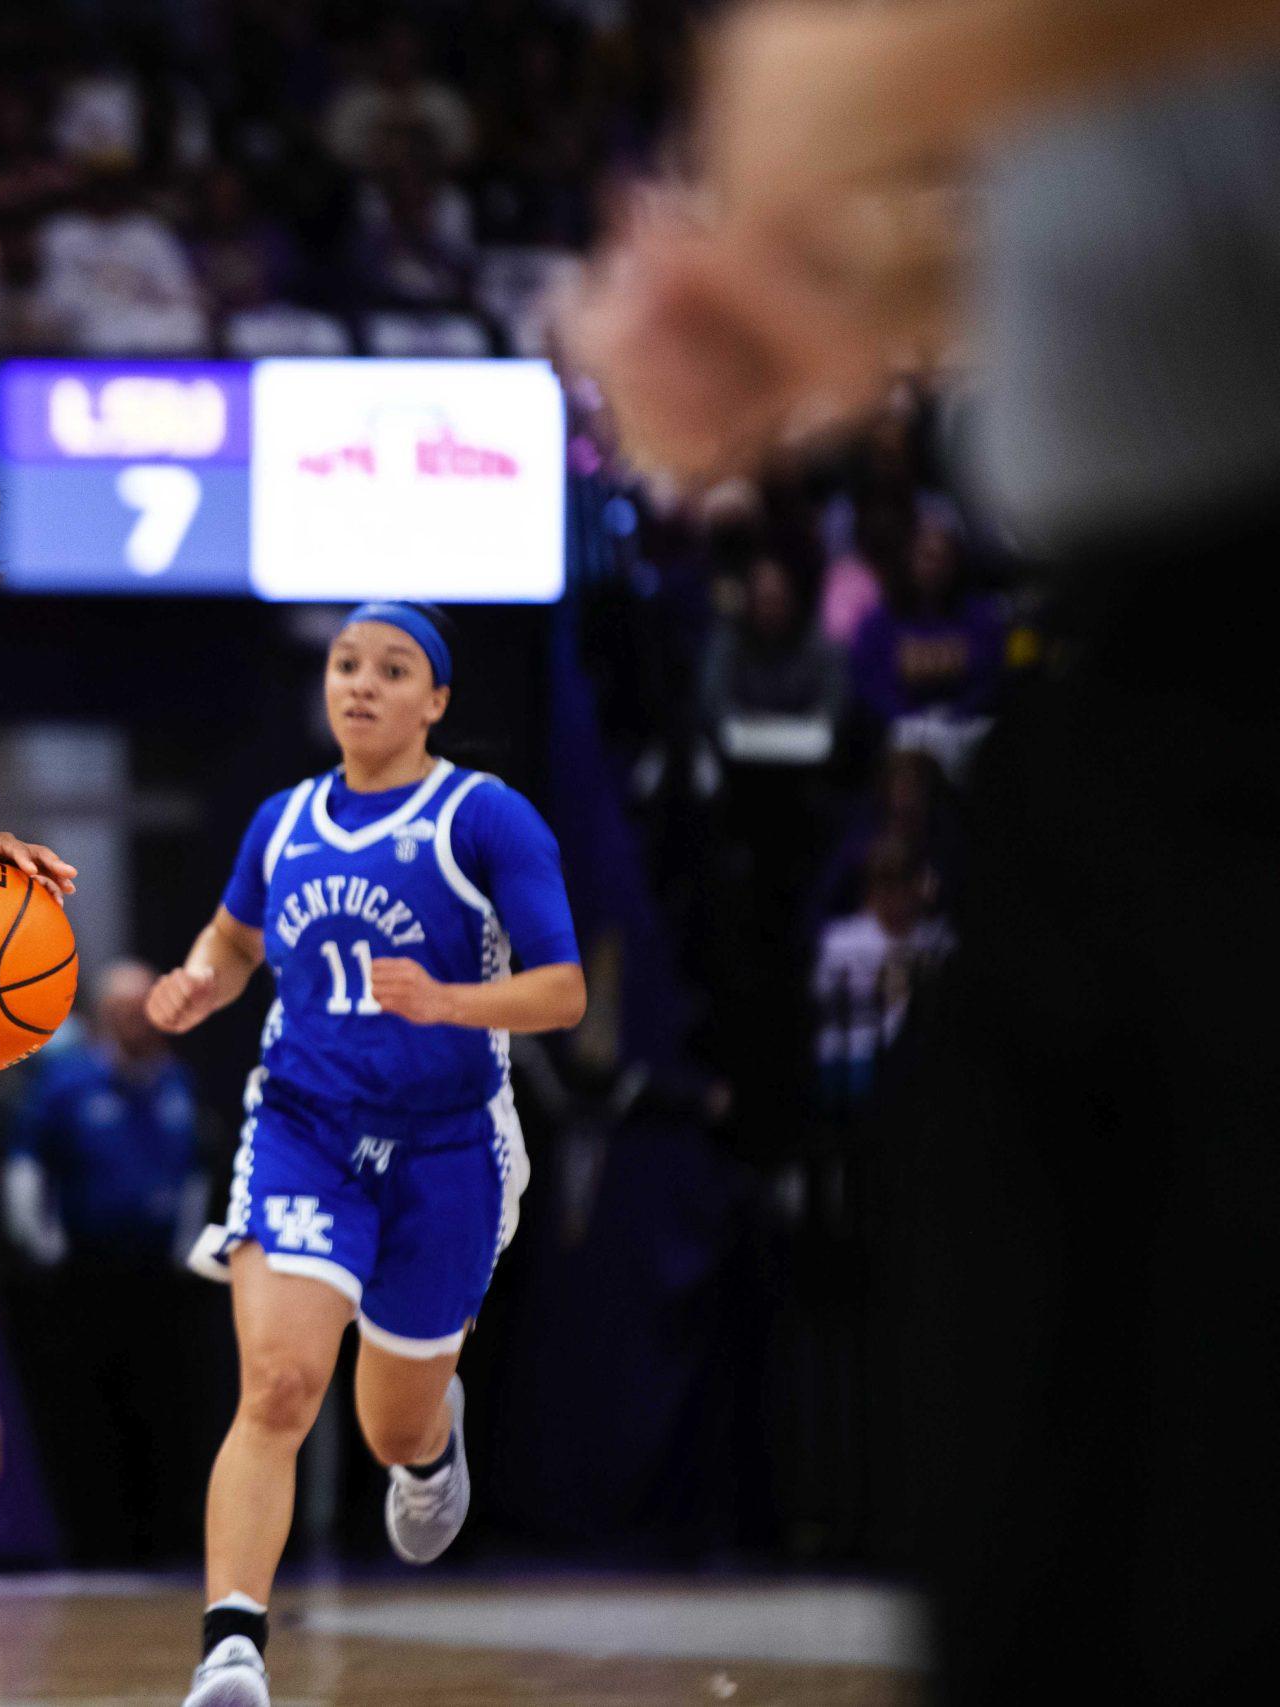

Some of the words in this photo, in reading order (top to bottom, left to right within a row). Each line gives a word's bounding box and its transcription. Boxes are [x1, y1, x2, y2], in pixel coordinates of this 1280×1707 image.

[116, 465, 201, 576] 7
[276, 874, 426, 949] KENTUCKY
[320, 940, 382, 1016] 11
[264, 1194, 334, 1254] UK
